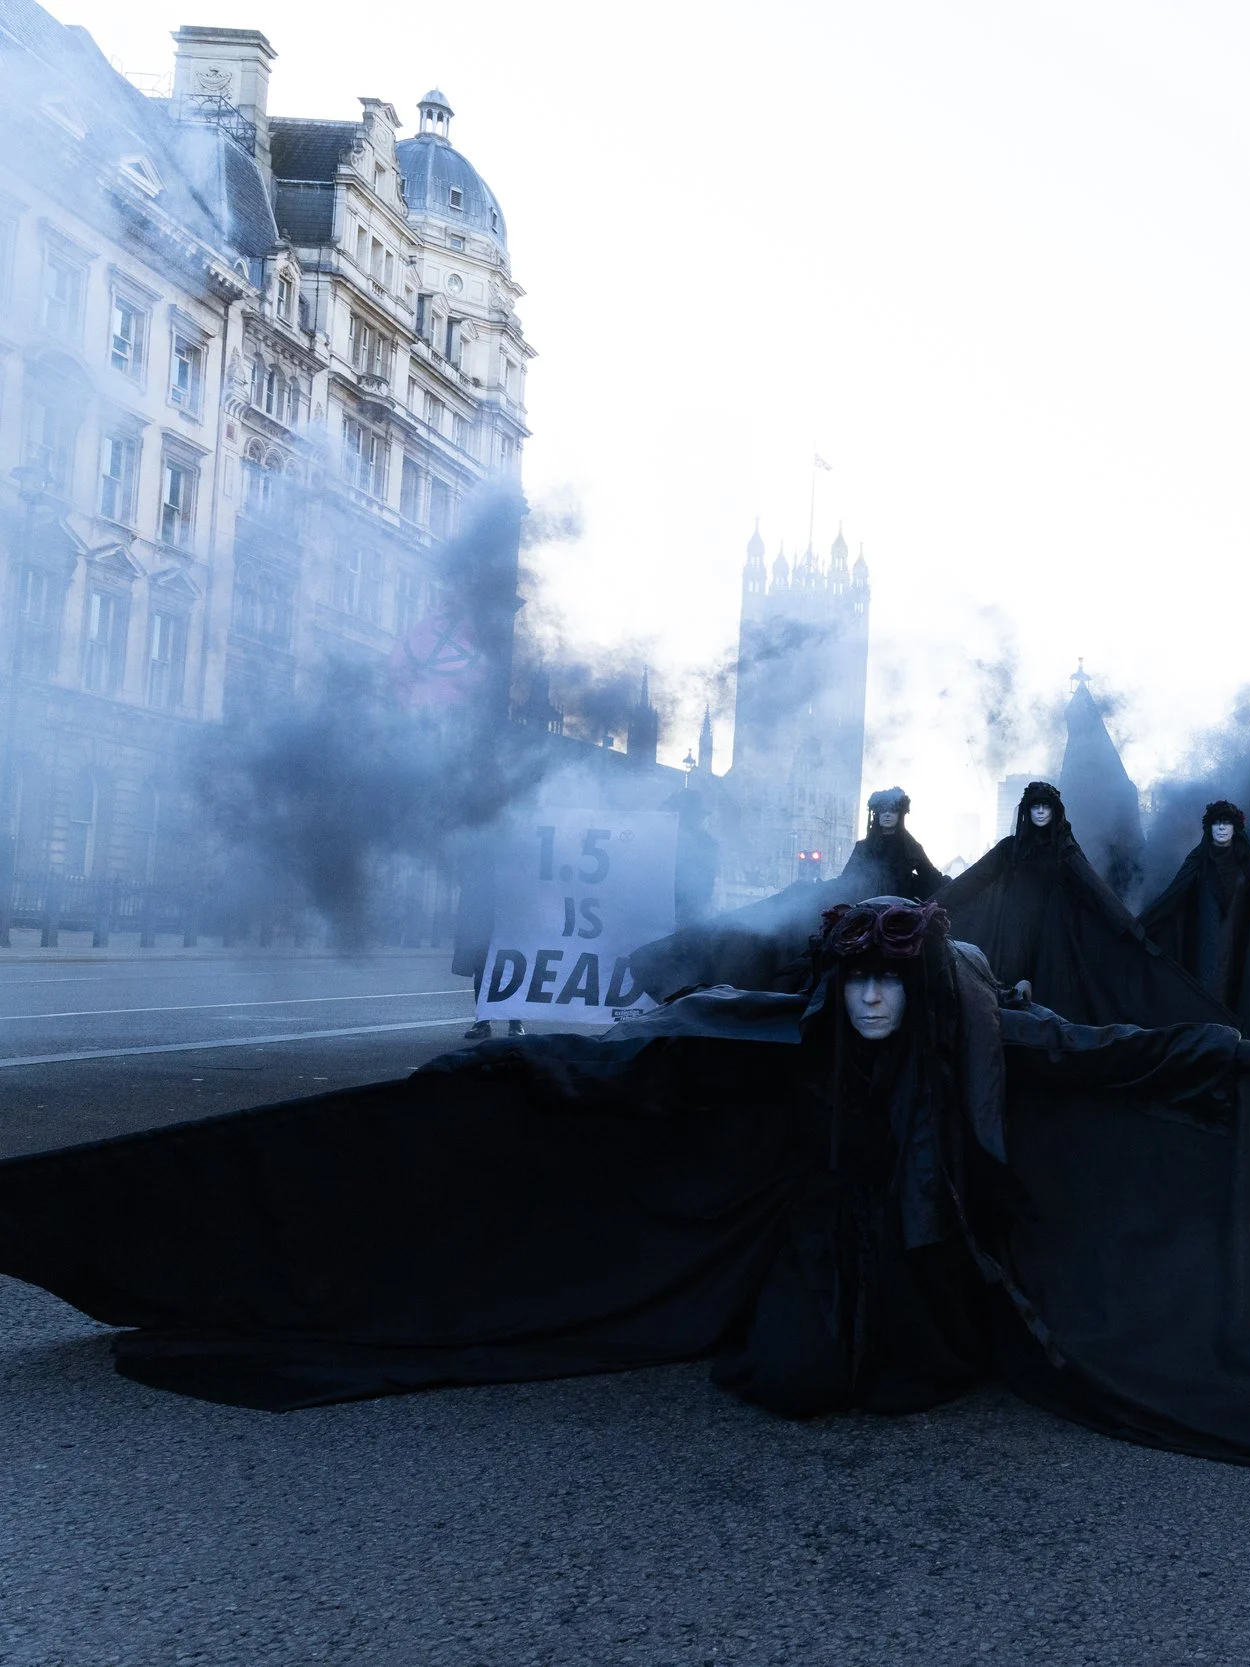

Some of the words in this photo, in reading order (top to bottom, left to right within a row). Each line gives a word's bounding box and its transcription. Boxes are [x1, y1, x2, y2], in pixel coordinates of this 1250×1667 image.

[536, 825, 611, 884] 1.5
[561, 897, 604, 939] IS
[486, 949, 645, 1008] DEAD
